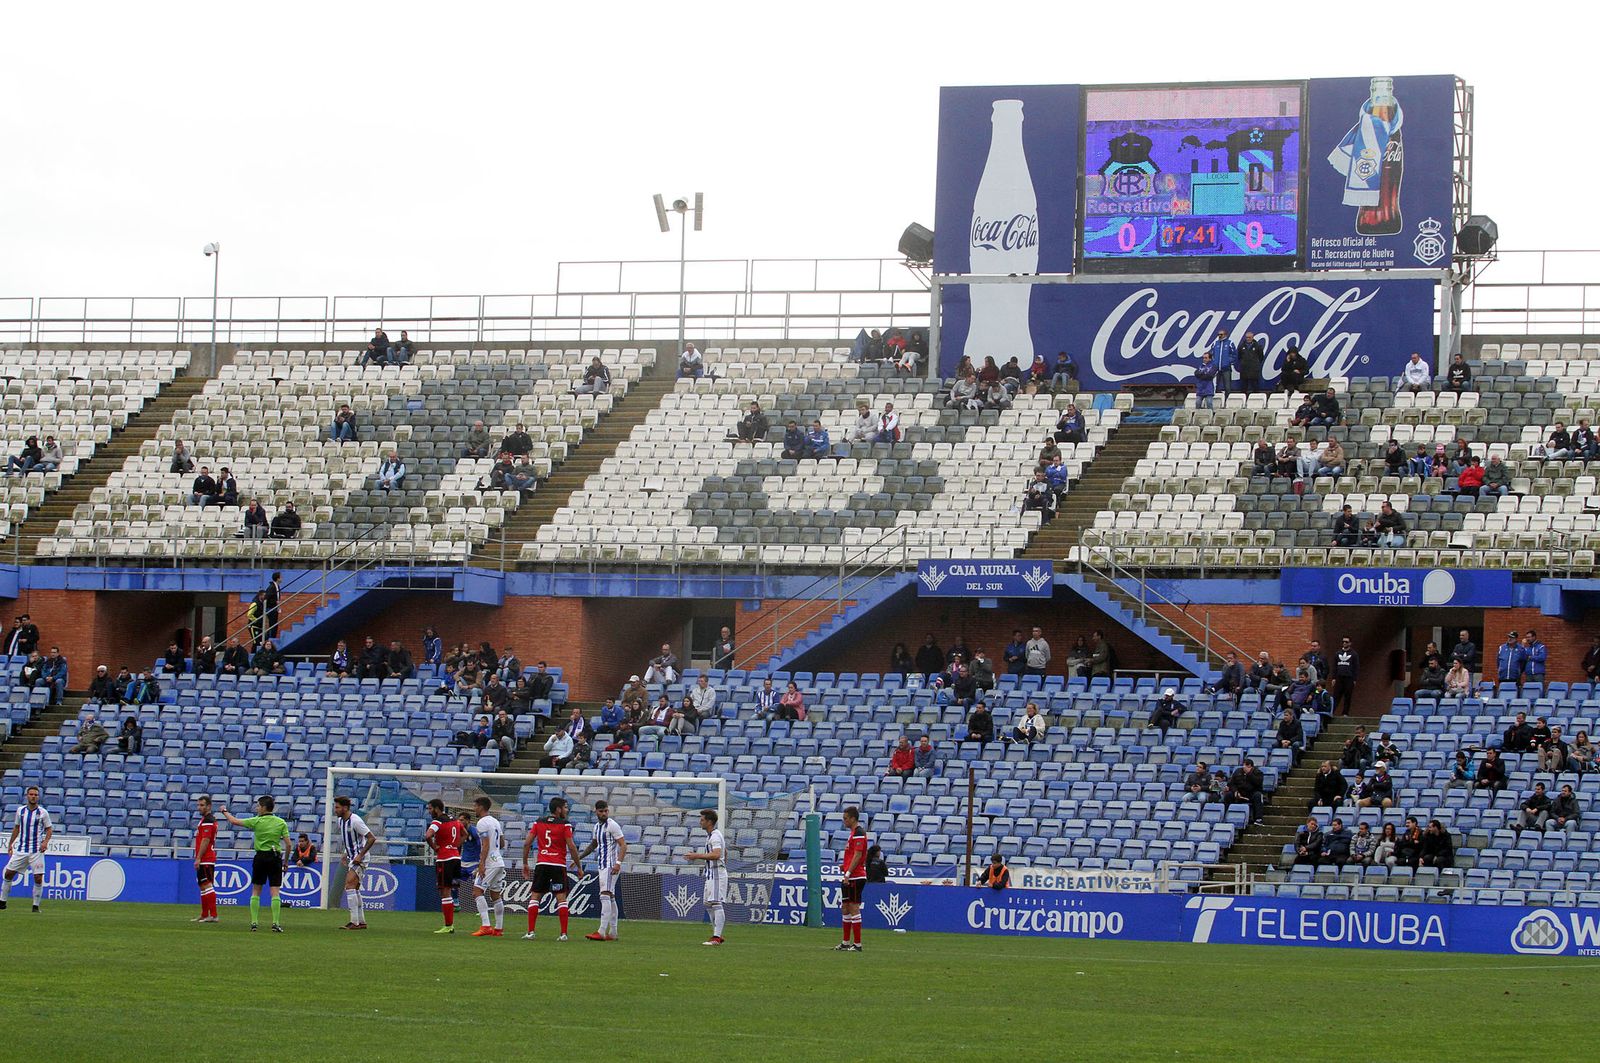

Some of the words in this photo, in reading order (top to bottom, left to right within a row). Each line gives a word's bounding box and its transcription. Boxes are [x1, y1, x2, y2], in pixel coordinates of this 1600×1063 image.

[1087, 200, 1172, 214] Recreativo
[972, 213, 1037, 251] Coca-Cola
[1118, 223, 1136, 251] 0
[1163, 226, 1215, 244] 07:41
[1246, 221, 1263, 249] 0
[1311, 238, 1341, 248] Refresco
[1342, 237, 1364, 247] Oficial
[1311, 250, 1324, 259] R.C.
[1325, 248, 1361, 259] Recreativo
[1362, 248, 1371, 258] de
[1372, 248, 1394, 258] Huelva
[1091, 286, 1380, 382] Coca-Cola
[949, 565, 977, 577] CAJA
[980, 564, 1020, 576] RURAL
[966, 582, 983, 591] DEL
[986, 582, 1003, 591] SUR
[1338, 572, 1410, 594] Onuba
[1379, 595, 1410, 605] FRUIT
[451, 826, 457, 843] 9
[545, 830, 552, 848] 5
[756, 862, 795, 874] PEÑA
[280, 872, 315, 890] KIA
[48, 888, 84, 900] FRUIT
[216, 897, 238, 905] EYSER
[726, 882, 772, 907] AJA
[779, 884, 865, 910] RURA
[750, 907, 784, 924] DEL
[967, 898, 1124, 939] Cruzcampo
[1233, 907, 1446, 947] TELEONUBA
